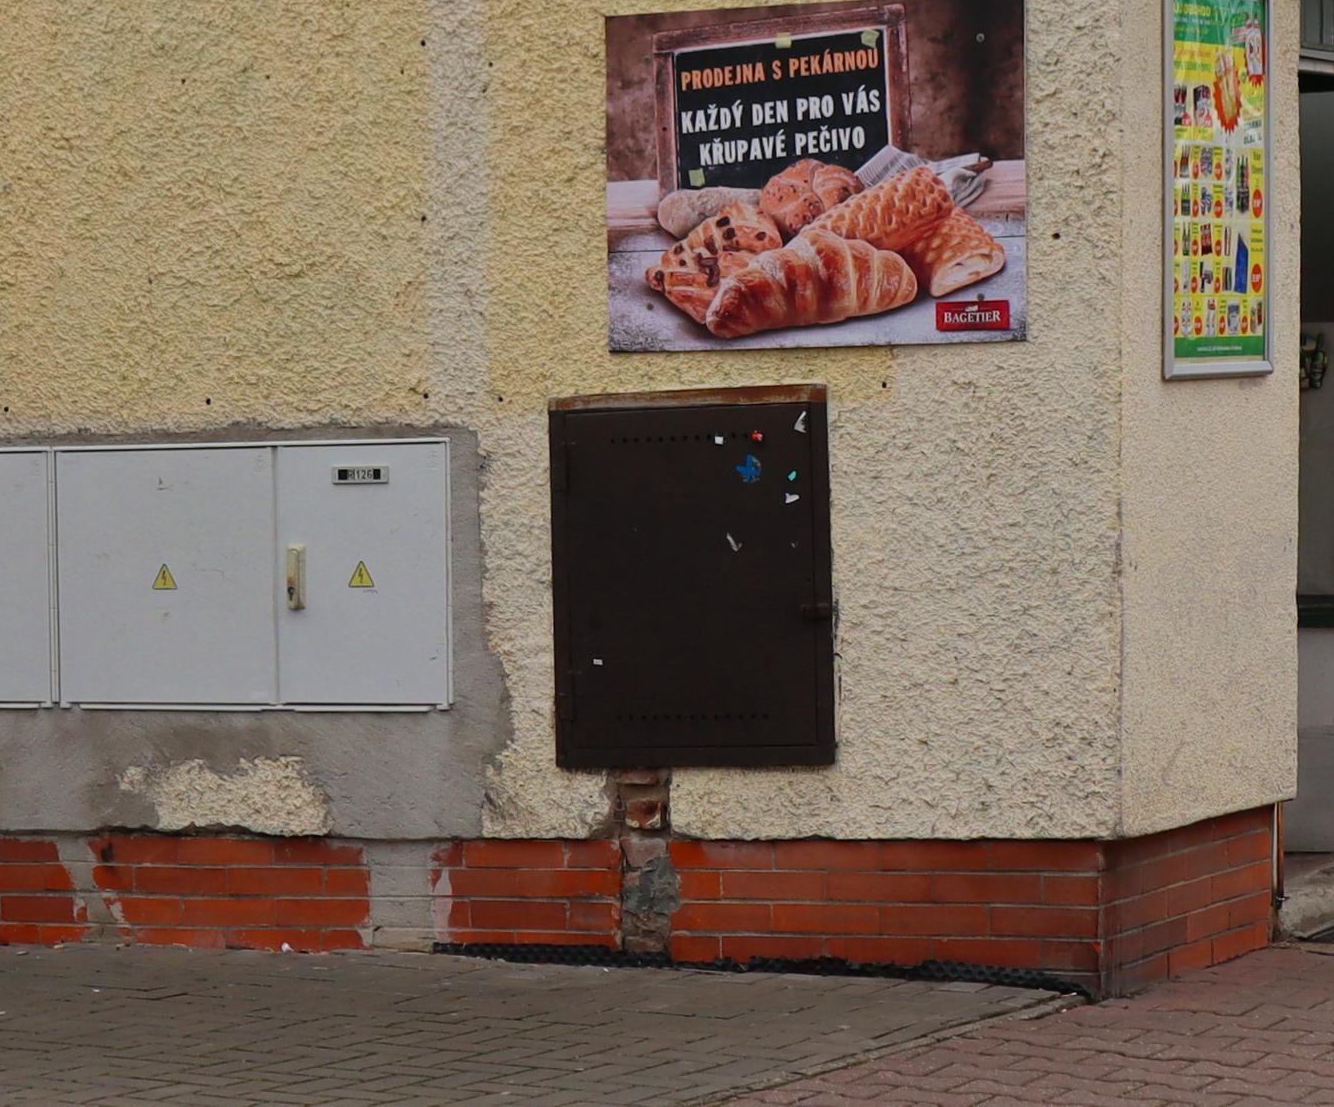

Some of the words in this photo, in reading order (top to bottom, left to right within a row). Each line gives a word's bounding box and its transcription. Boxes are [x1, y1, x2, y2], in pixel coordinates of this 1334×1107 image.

[681, 61, 766, 92] PRODEJNA
[772, 60, 782, 80] S
[789, 47, 879, 79] PEKÁRNOU
[681, 99, 744, 135] KAŽDÝ
[752, 100, 789, 127] DEN
[796, 94, 835, 121] PRO
[842, 84, 881, 117] VÁS
[699, 129, 787, 167] KŘUPAVÉ
[795, 125, 866, 156] PEČIVO
[944, 310, 1001, 324] BAGETIER
